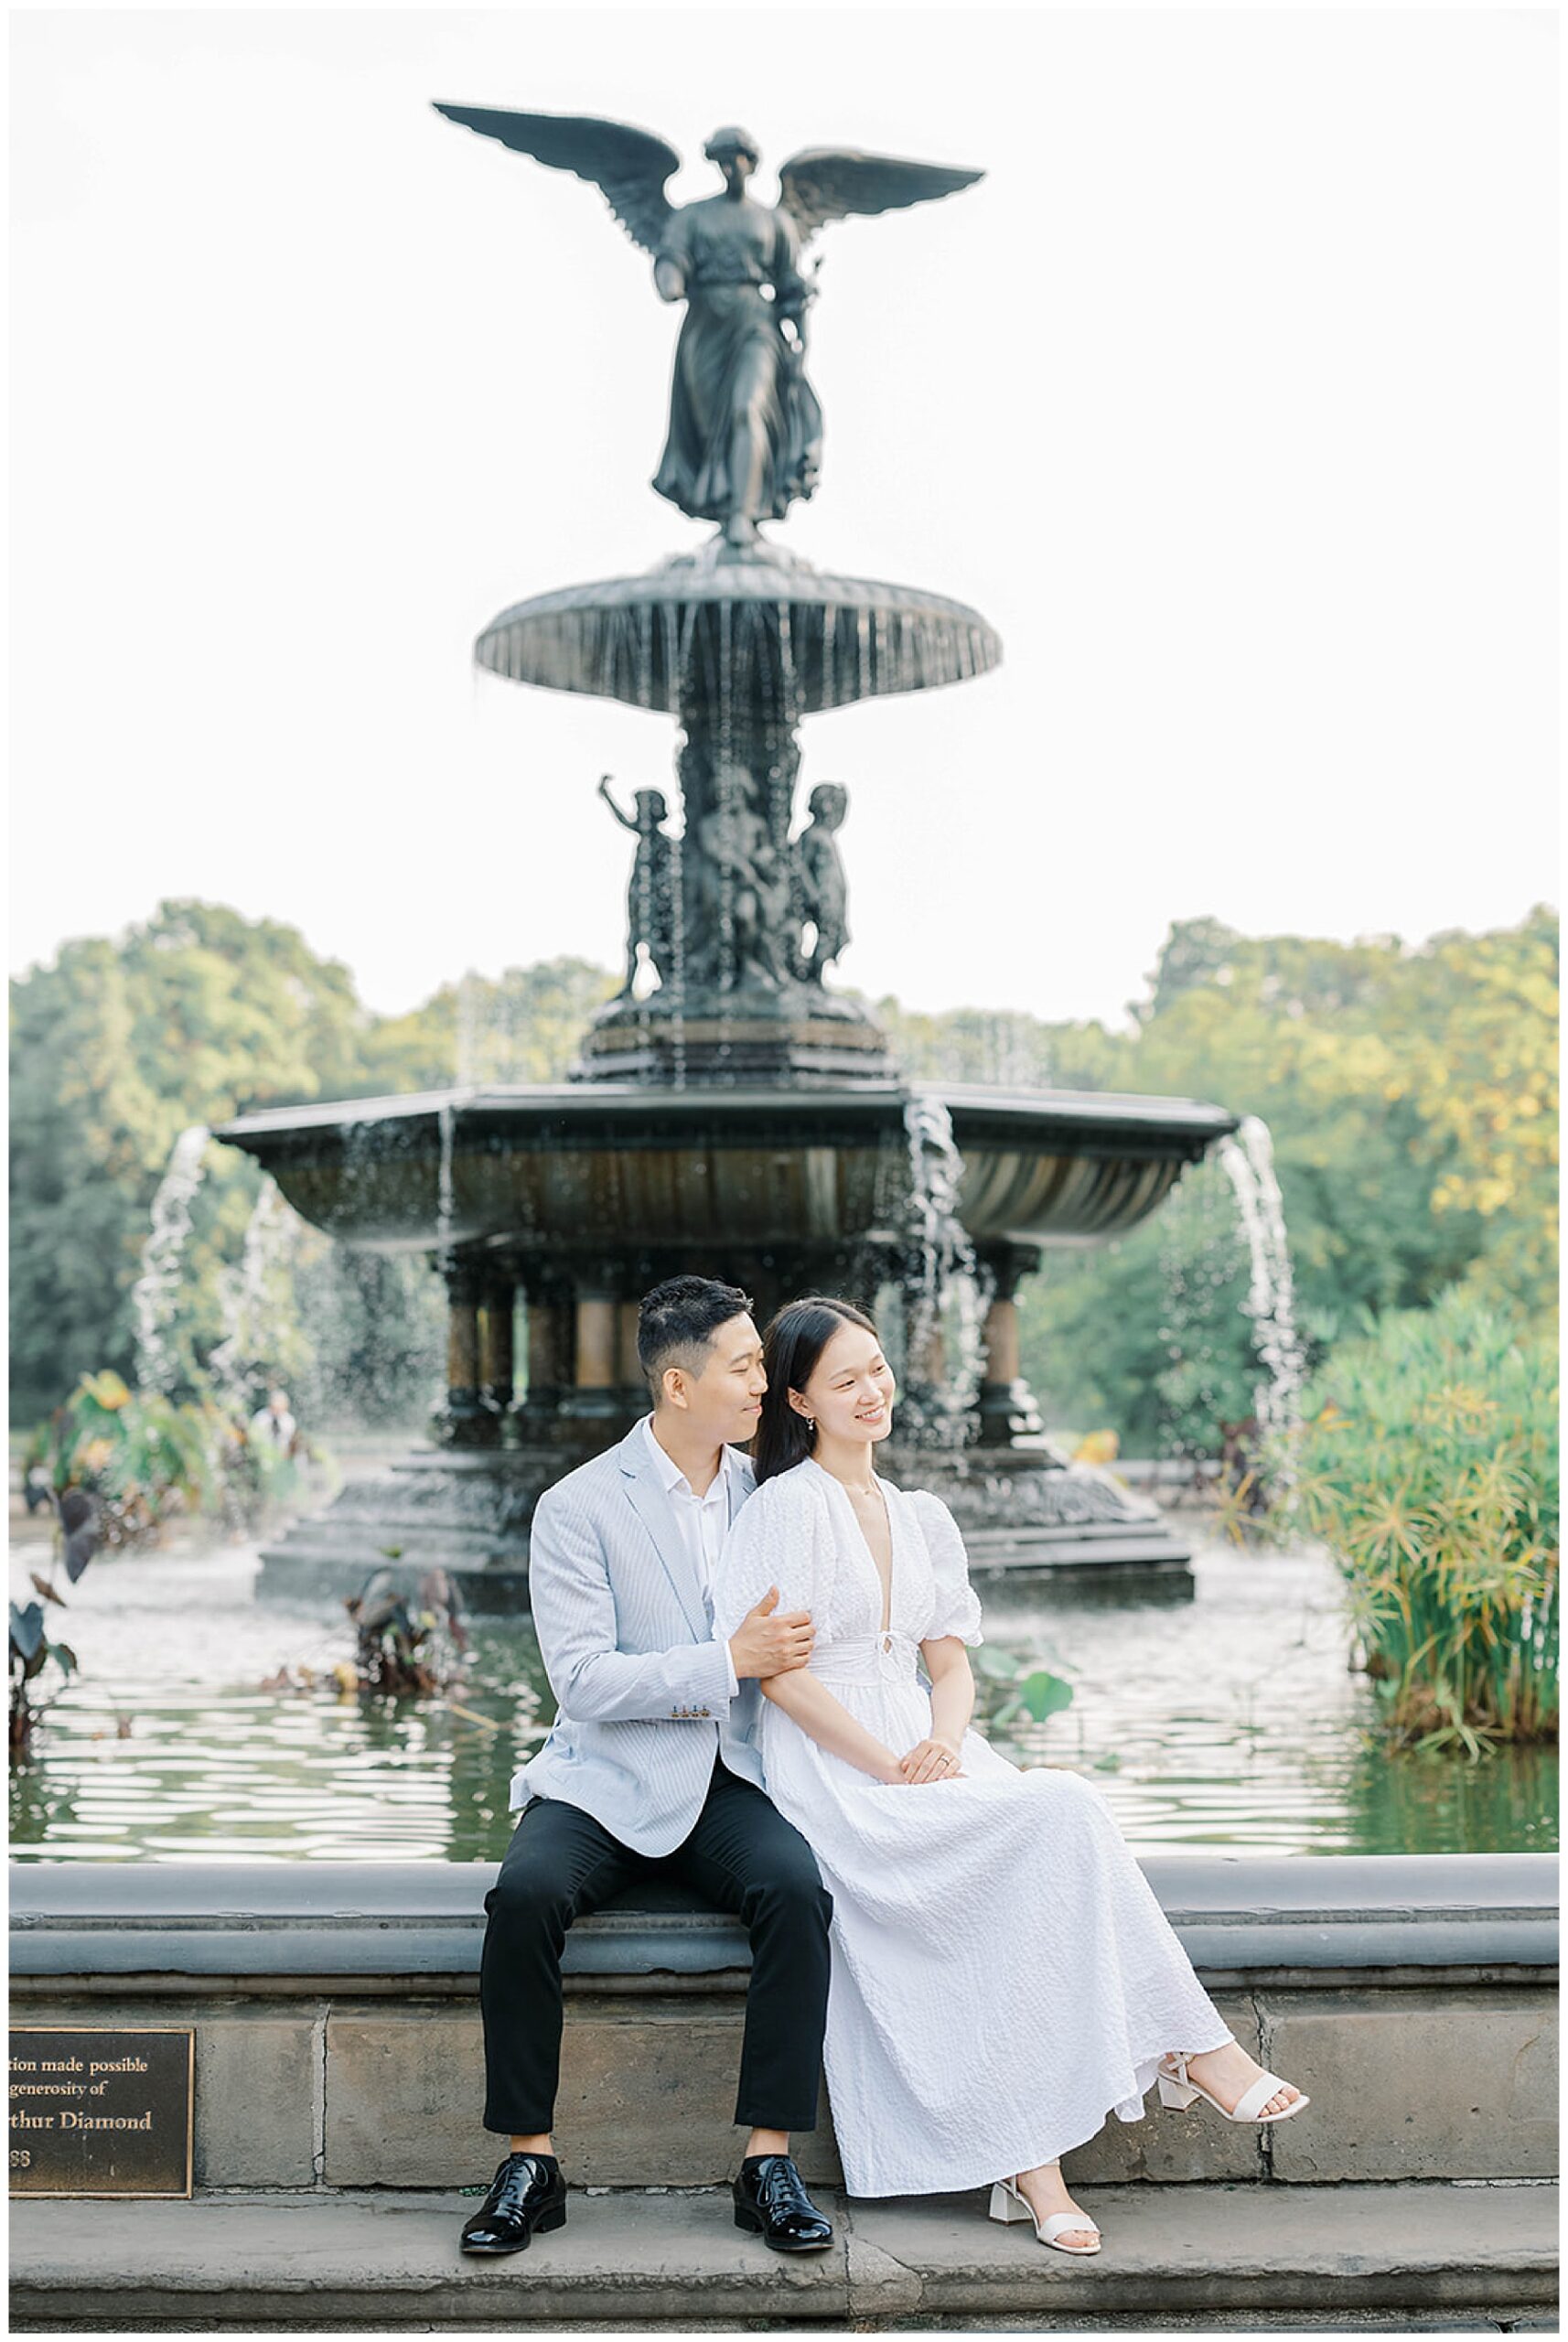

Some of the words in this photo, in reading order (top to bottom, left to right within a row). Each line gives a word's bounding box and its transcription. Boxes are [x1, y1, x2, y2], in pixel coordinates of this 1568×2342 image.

[41, 2057, 84, 2072] made
[90, 2057, 148, 2076] possible
[9, 2080, 87, 2100] generosity
[89, 2080, 109, 2095] of
[59, 2111, 153, 2130] Diamond
[9, 2150, 31, 2167] 88
